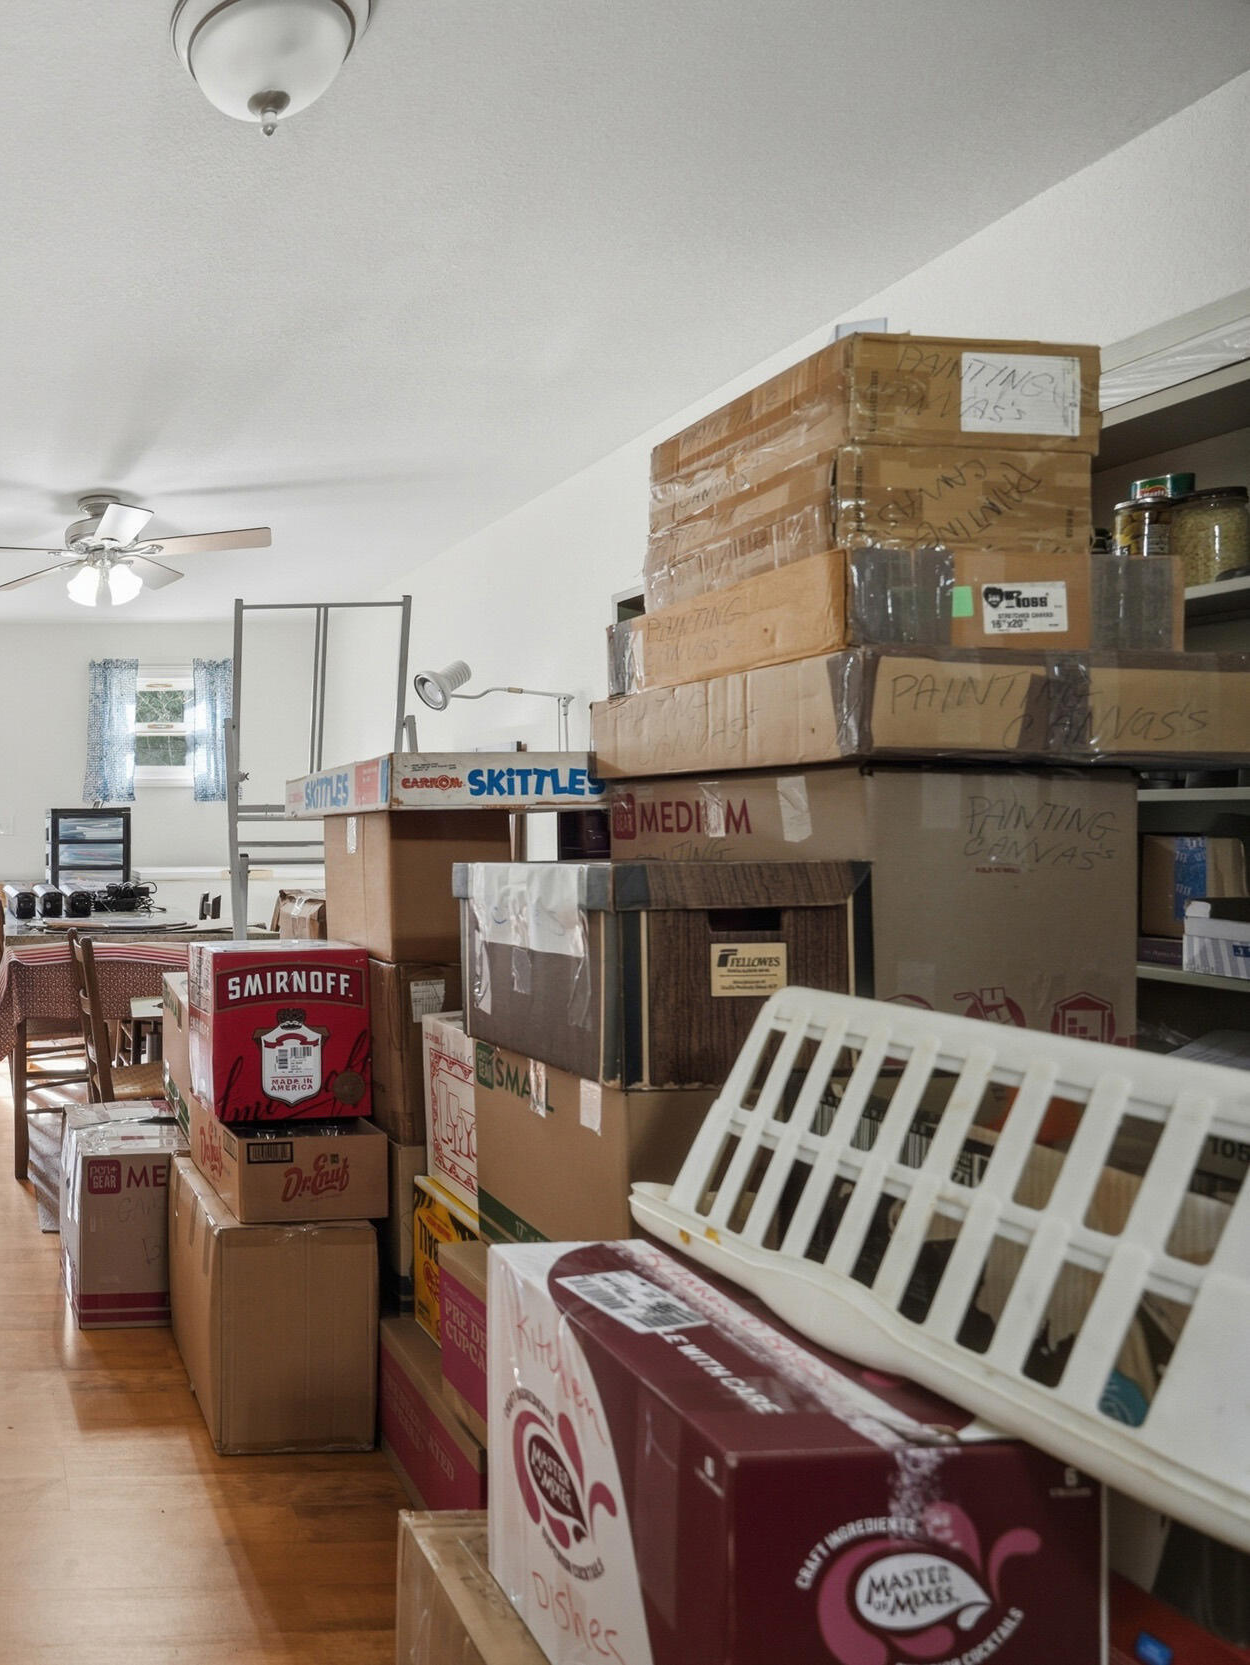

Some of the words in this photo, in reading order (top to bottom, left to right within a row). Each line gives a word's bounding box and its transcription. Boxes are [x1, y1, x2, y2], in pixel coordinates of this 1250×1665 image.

[640, 798, 752, 835] MEDIM
[966, 795, 1122, 841] PAINTING
[228, 971, 351, 1000] SMIRNOFF
[495, 1056, 554, 1113] SMAL
[93, 1174, 117, 1189] GEAR
[126, 1165, 167, 1188] ME
[444, 1298, 469, 1334] PRE
[470, 1318, 488, 1352] DE
[444, 1319, 488, 1374] CUPCA
[676, 1343, 733, 1377] WITH
[719, 1376, 785, 1416] CARE
[795, 1543, 830, 1590] CRAFT
[824, 1517, 918, 1550] INGREDIENTS
[866, 1565, 952, 1605] MASTER
